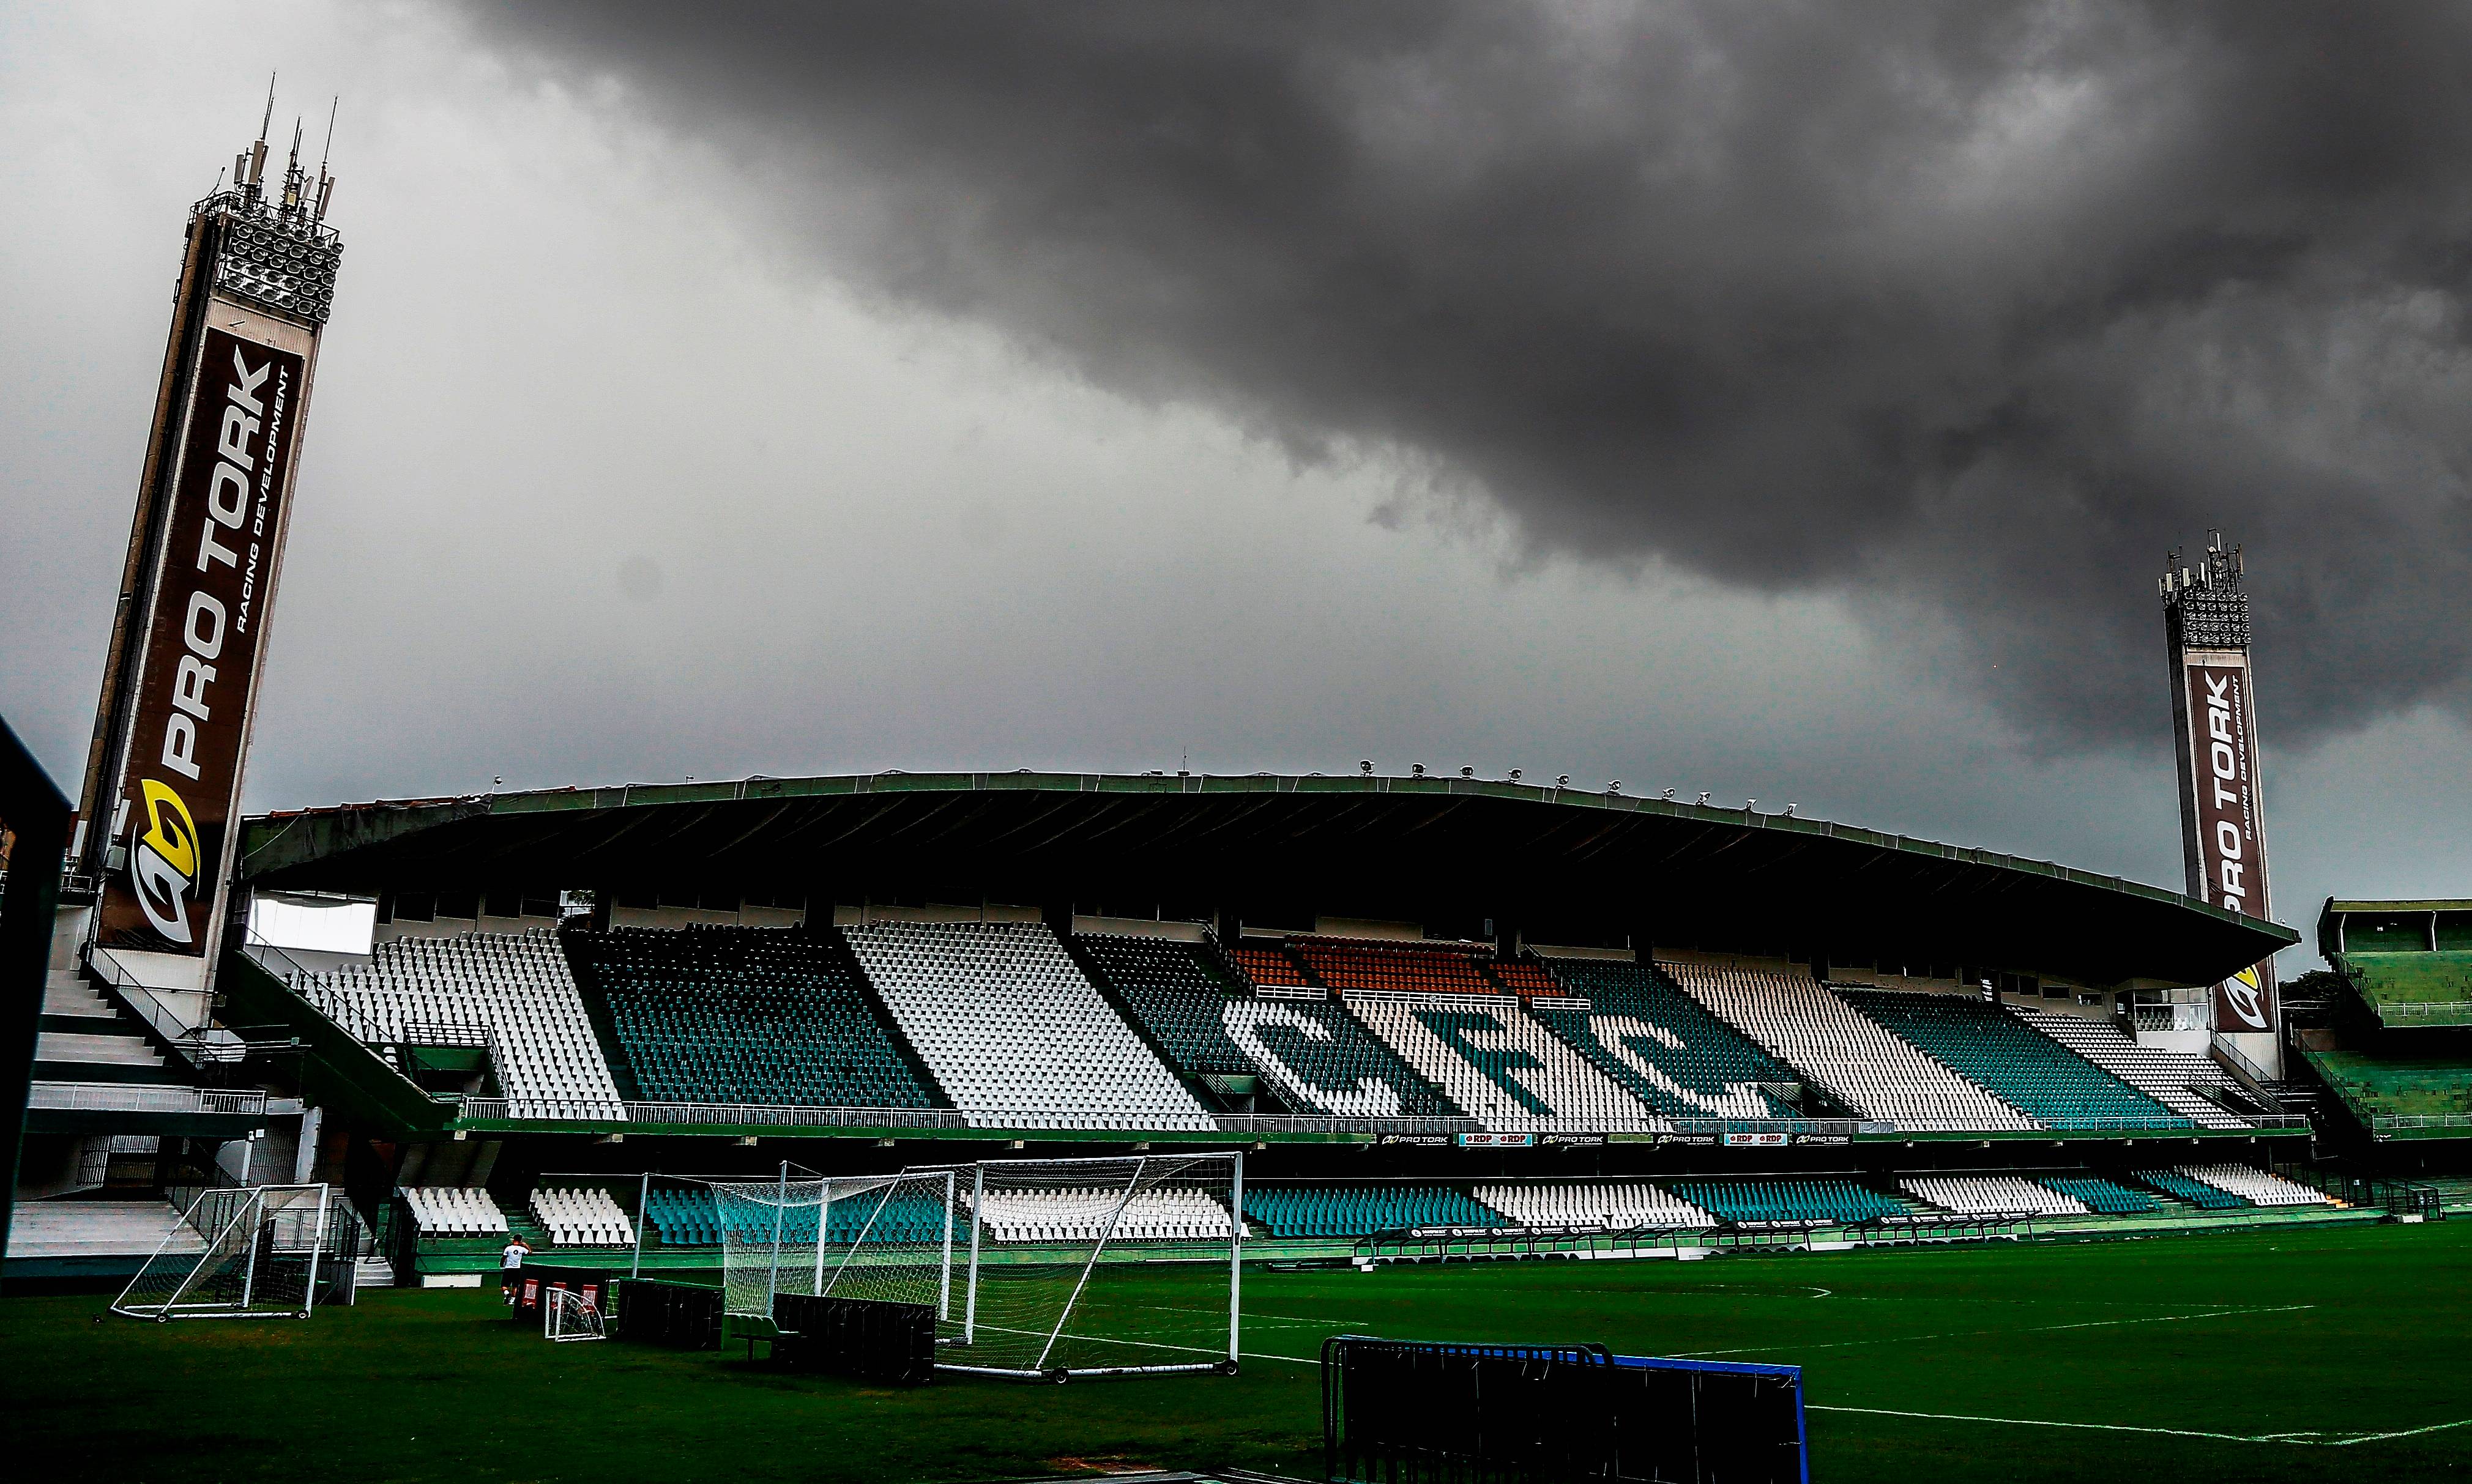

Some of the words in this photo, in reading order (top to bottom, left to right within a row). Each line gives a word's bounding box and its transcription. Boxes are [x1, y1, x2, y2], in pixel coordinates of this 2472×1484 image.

[237, 543, 260, 634] RACING
[253, 365, 289, 537] DEVELOPMENT
[162, 590, 226, 781] PRO
[196, 344, 271, 572] TORK
[2205, 670, 2238, 811] TORK
[2232, 675, 2247, 782] DEVELOPMENT
[2241, 784, 2252, 841] RACING
[1223, 1000, 1771, 1118] CFC
[1507, 1135, 1526, 1143] RDP
